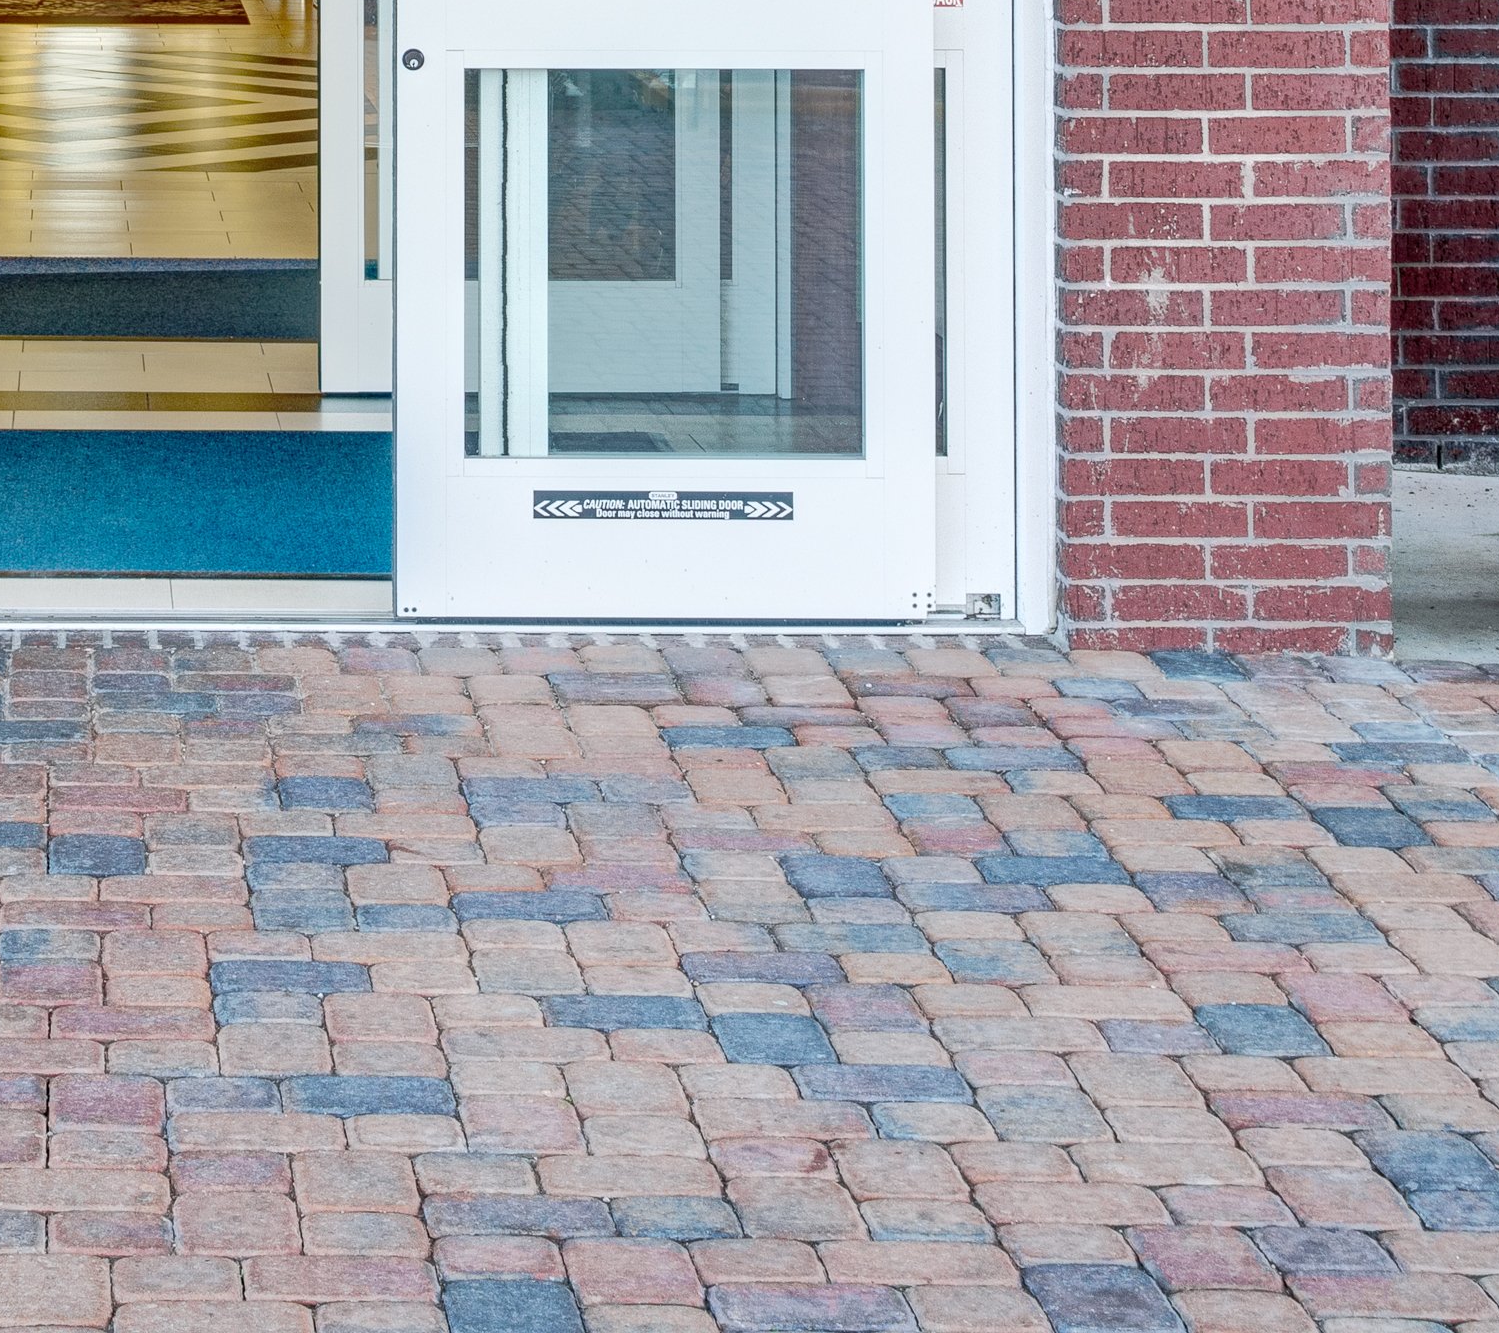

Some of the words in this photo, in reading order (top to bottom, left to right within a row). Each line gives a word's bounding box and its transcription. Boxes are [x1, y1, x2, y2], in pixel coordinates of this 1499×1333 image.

[583, 499, 625, 509] CAUTION:
[627, 499, 680, 510] AUTOMATIC
[681, 500, 717, 510] SLIDING
[718, 500, 744, 510] DOOR
[596, 508, 616, 518] Door
[618, 510, 636, 519] may
[637, 509, 660, 518] close
[661, 509, 694, 518] without
[694, 509, 730, 520] warning
